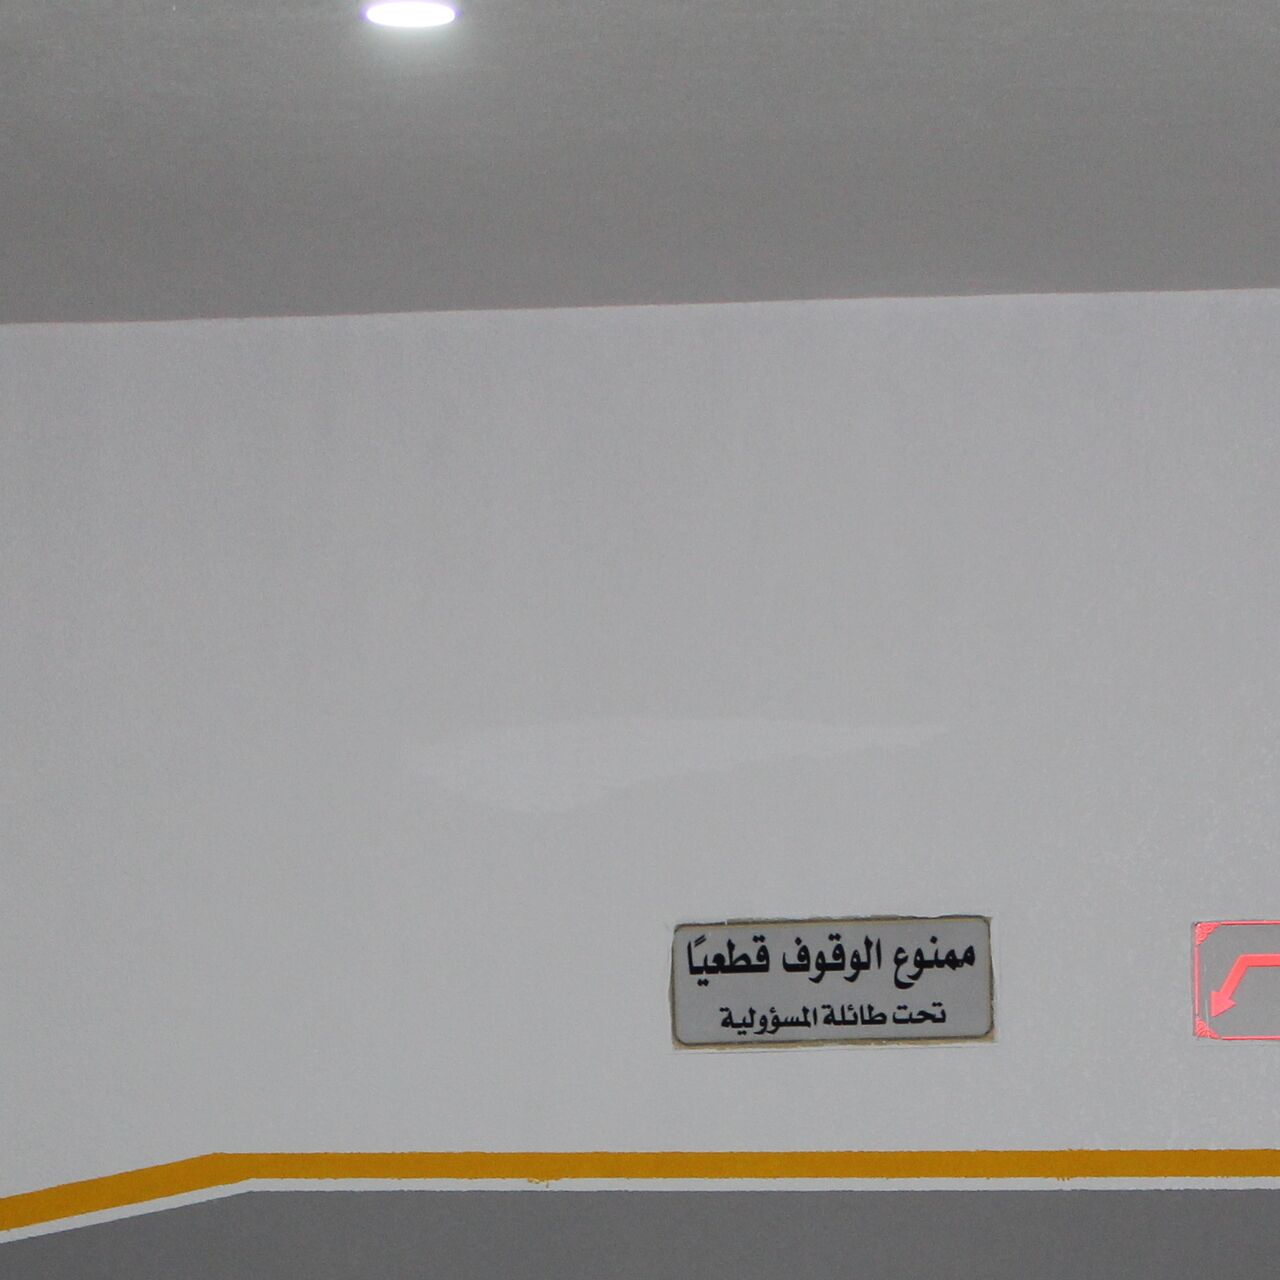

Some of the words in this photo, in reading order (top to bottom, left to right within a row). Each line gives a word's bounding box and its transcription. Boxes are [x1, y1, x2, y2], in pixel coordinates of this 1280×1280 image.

[782, 933, 882, 984] الوقوف
[893, 936, 975, 989] ممنوع
[719, 1006, 818, 1035] المسؤولية
[821, 1004, 887, 1026] طائلة
[892, 1002, 946, 1024] تحت
